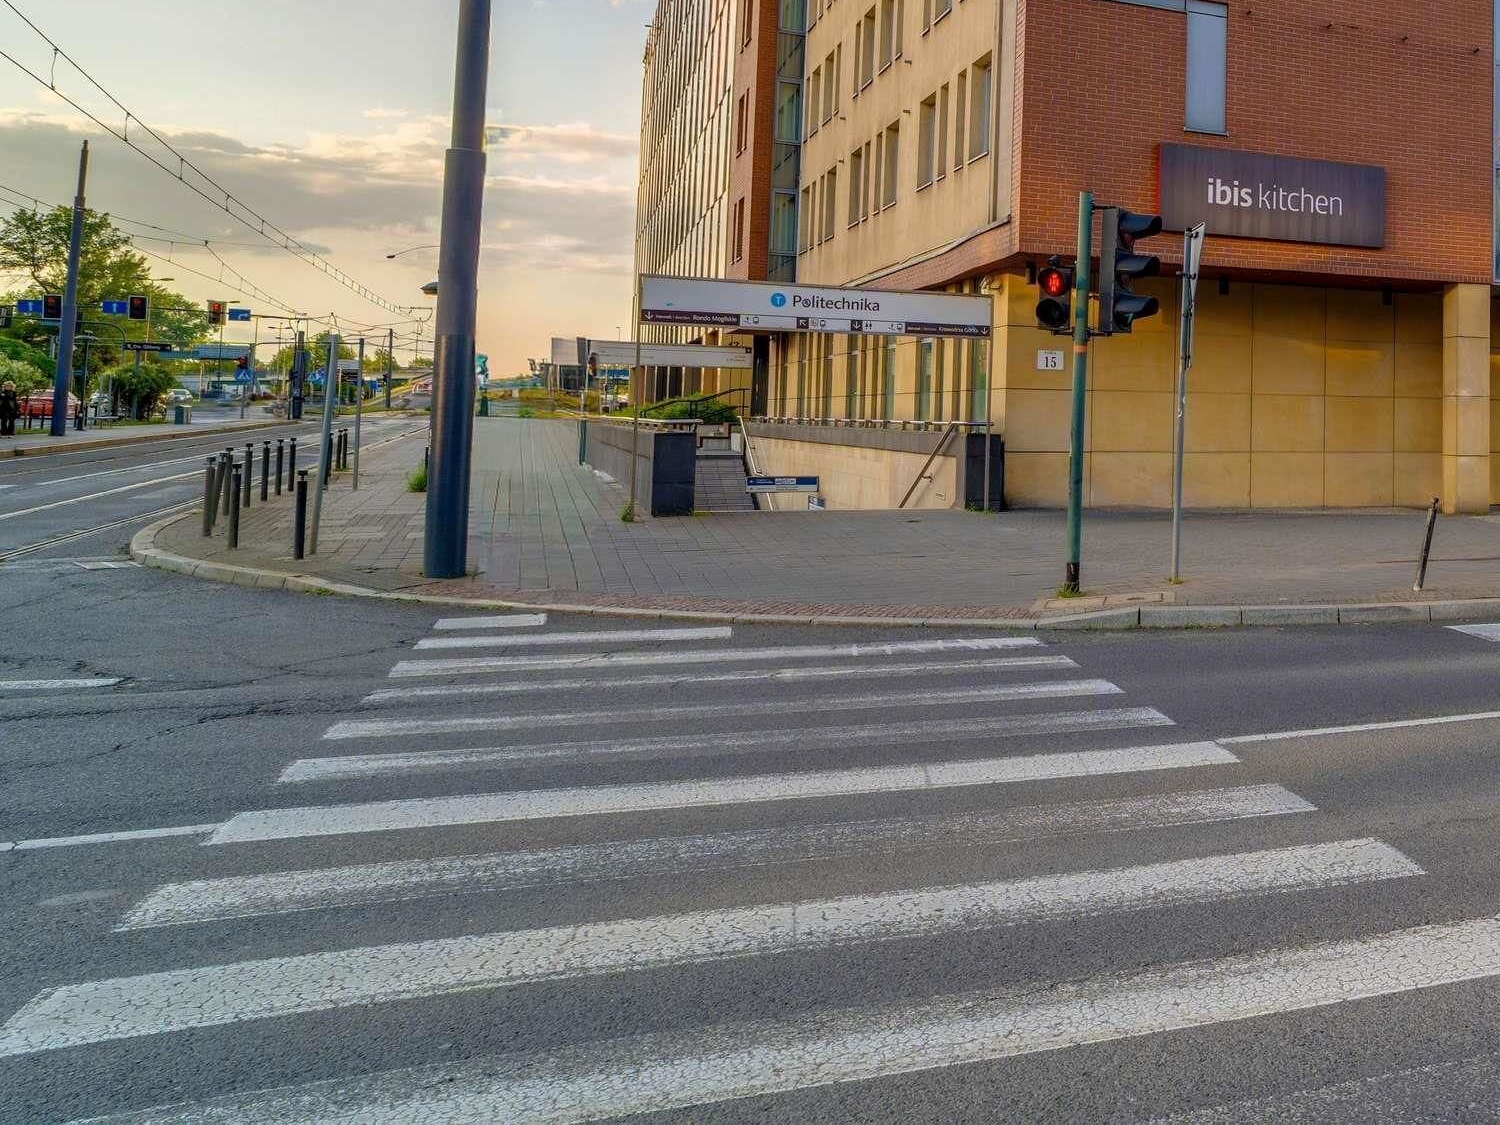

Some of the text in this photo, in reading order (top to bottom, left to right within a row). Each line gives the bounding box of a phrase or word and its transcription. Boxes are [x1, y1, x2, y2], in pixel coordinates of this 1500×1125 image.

[1207, 177, 1343, 216] ibis kitchen
[792, 294, 880, 312] Politechnika
[692, 314, 712, 322] Rondo
[1044, 356, 1057, 368] 15
